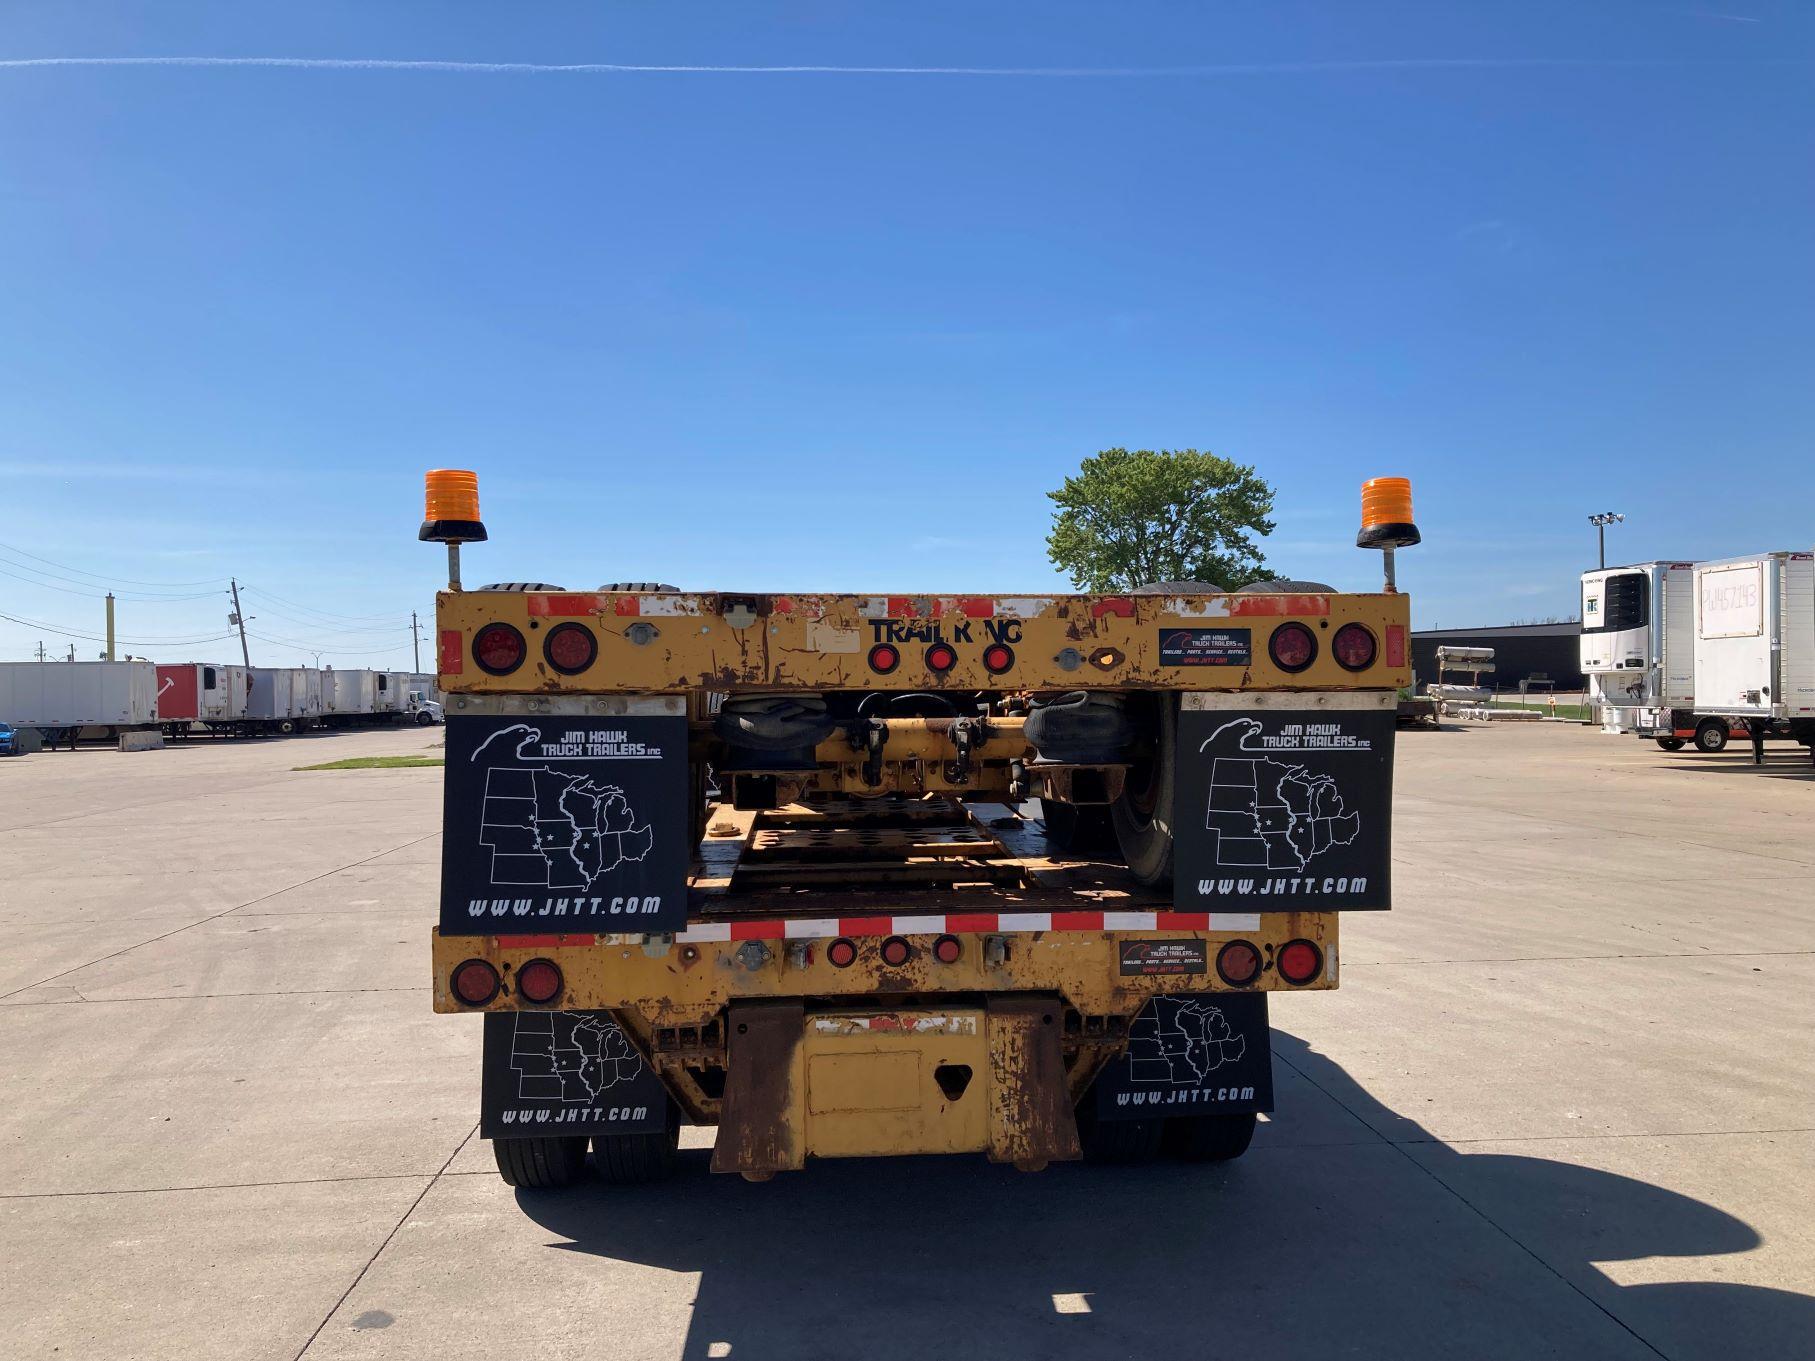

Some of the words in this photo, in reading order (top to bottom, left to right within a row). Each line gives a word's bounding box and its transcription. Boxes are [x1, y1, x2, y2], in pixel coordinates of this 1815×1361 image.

[868, 619, 949, 643] TRAIL
[954, 619, 1023, 644] KNG
[560, 731, 585, 743] JIM
[589, 731, 628, 743] HAWK
[1280, 724, 1302, 735] JIM
[1306, 724, 1340, 735] HAWK
[541, 743, 583, 756] TRUCK
[586, 743, 646, 756] TRAILERS
[1262, 736, 1299, 747] TRUCK
[1302, 736, 1356, 747] TRAILERS
[1198, 877, 1367, 895] WWW.JHTT.COM
[468, 896, 661, 917] WWW.JHTT.COM
[1117, 1086, 1255, 1106] WWW.JHTT.COM
[502, 1107, 647, 1124] WWW.JHTT.COM
